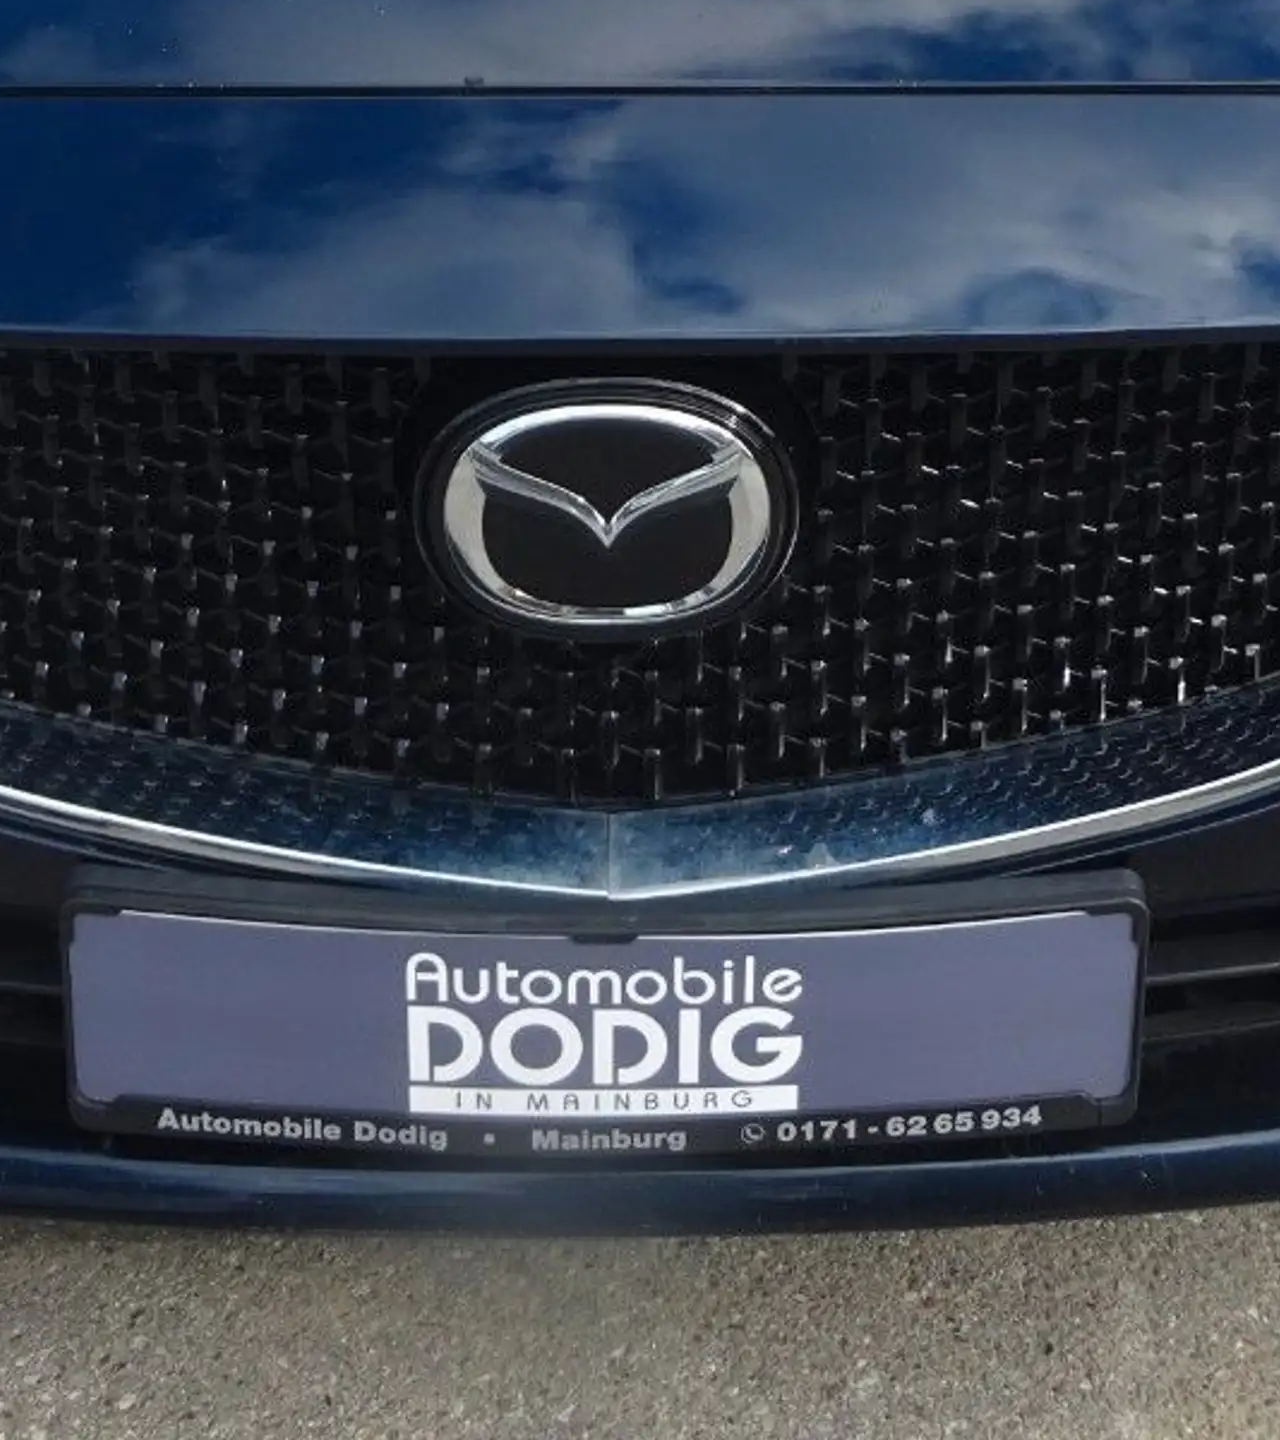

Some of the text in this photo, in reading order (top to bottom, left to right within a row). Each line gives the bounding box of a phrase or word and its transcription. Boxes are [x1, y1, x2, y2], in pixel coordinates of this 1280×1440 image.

[406, 952, 803, 1005] Automobile
[407, 1005, 803, 1086] DODIG
[456, 1089, 754, 1111] IN MAINBURG
[157, 1107, 342, 1142] Automobile
[353, 1120, 448, 1152] Dodig
[531, 1128, 688, 1152] Mainburg
[776, 1118, 857, 1143] 0171
